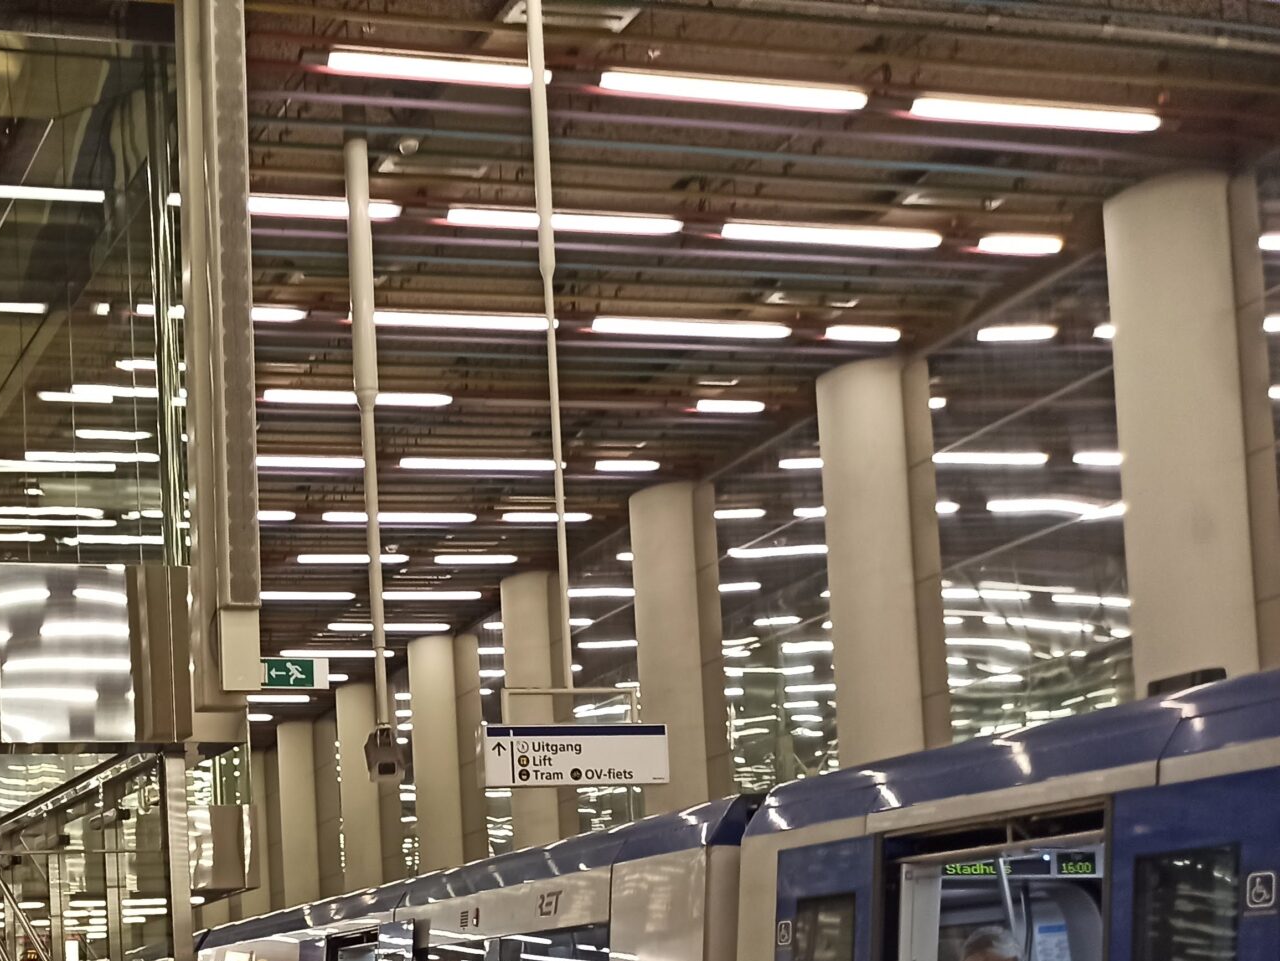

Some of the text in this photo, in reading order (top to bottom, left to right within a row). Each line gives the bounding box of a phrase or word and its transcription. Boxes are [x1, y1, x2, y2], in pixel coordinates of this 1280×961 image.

[532, 742, 582, 755] Uitgang
[532, 756, 553, 767] Lift
[532, 768, 634, 781] Tram OV-fiets
[945, 863, 1013, 875] Stadhus
